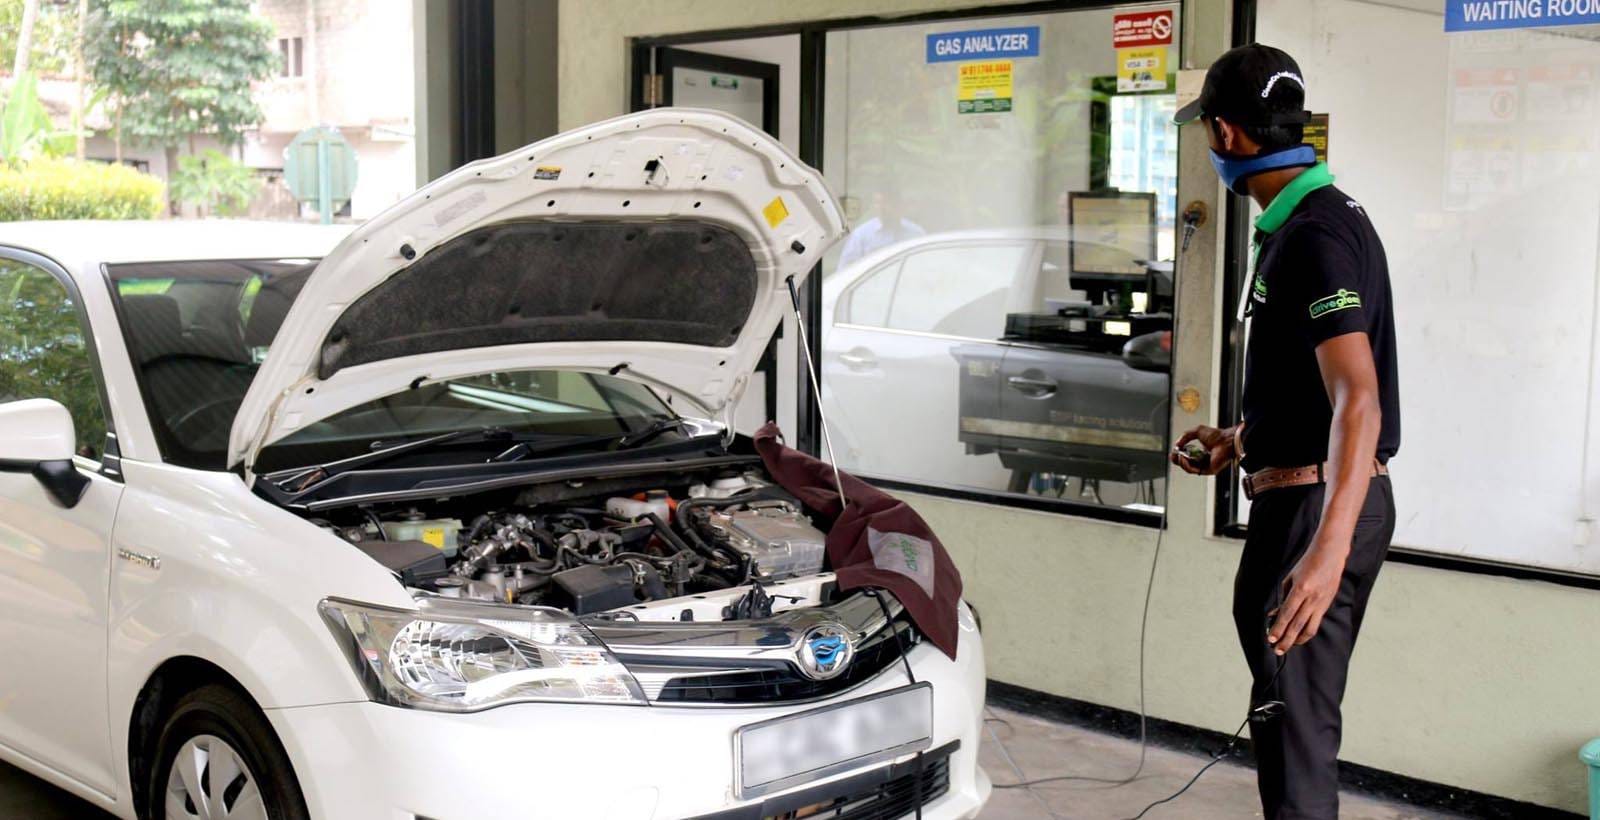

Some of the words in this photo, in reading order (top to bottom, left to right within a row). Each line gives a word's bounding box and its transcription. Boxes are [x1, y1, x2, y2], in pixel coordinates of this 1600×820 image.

[1463, 0, 1542, 22] WAITING
[936, 38, 961, 55] GAS
[963, 34, 1028, 53] ANALYZER
